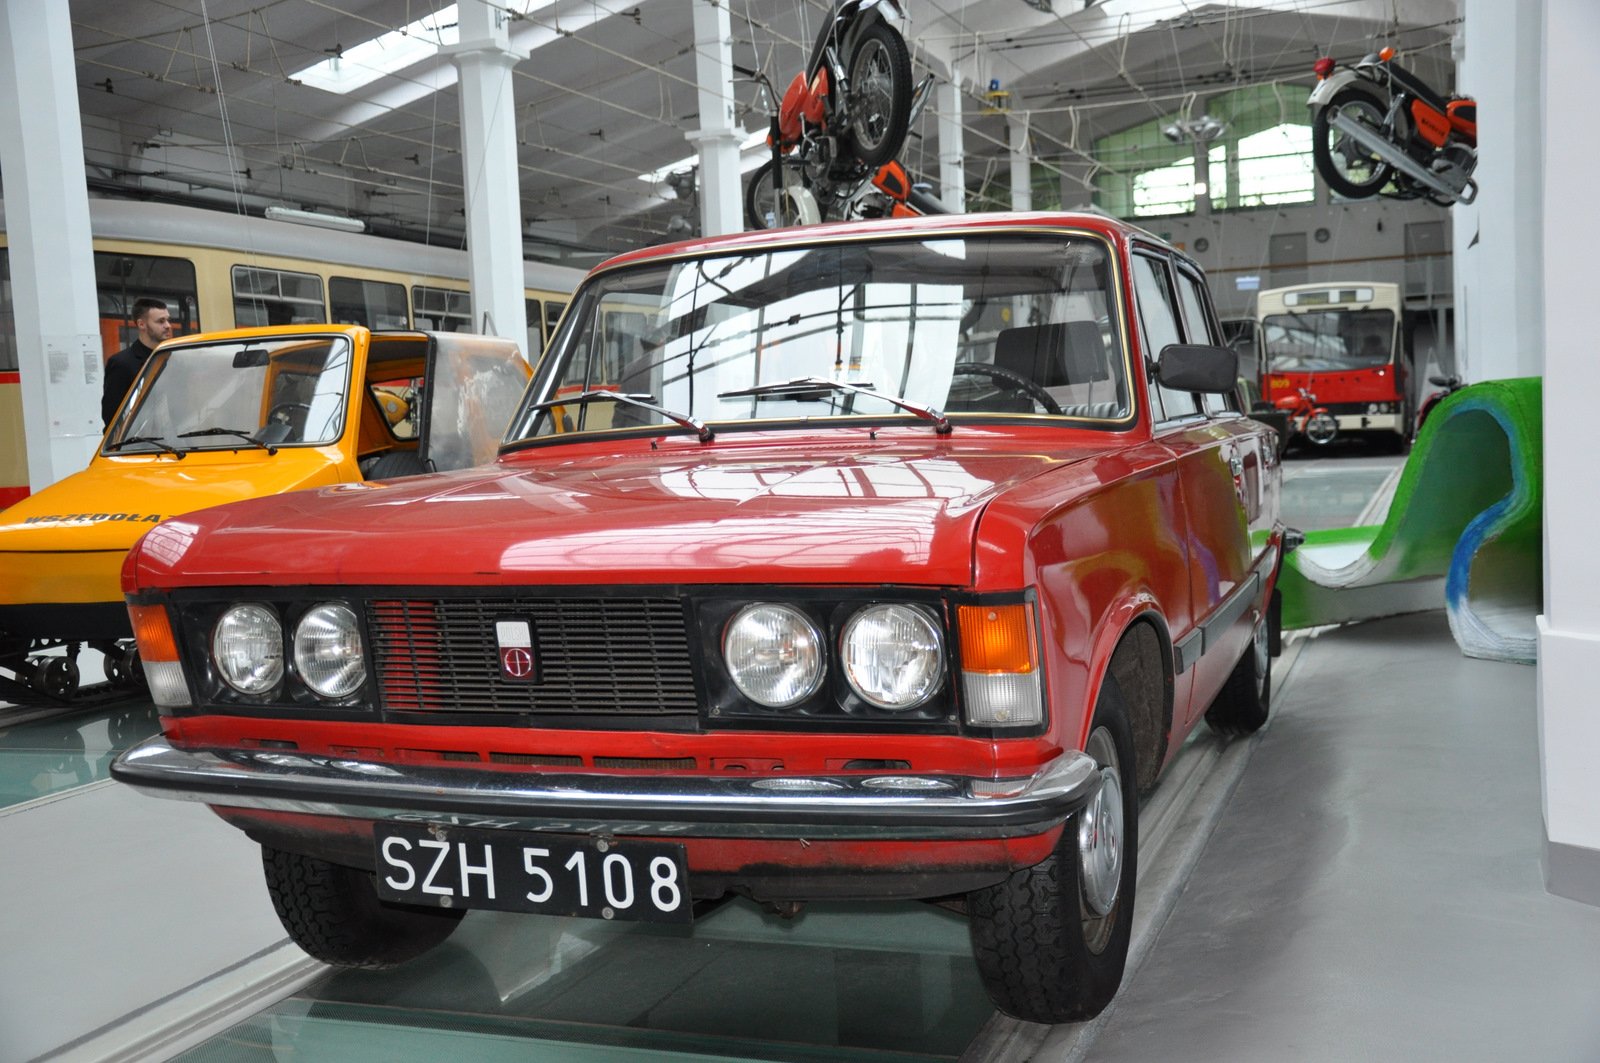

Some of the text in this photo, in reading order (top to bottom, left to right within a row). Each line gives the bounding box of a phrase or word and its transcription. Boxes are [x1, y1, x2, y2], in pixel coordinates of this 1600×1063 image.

[25, 513, 177, 524] WSZĘDOŁA
[382, 836, 681, 912] SZH 5108
